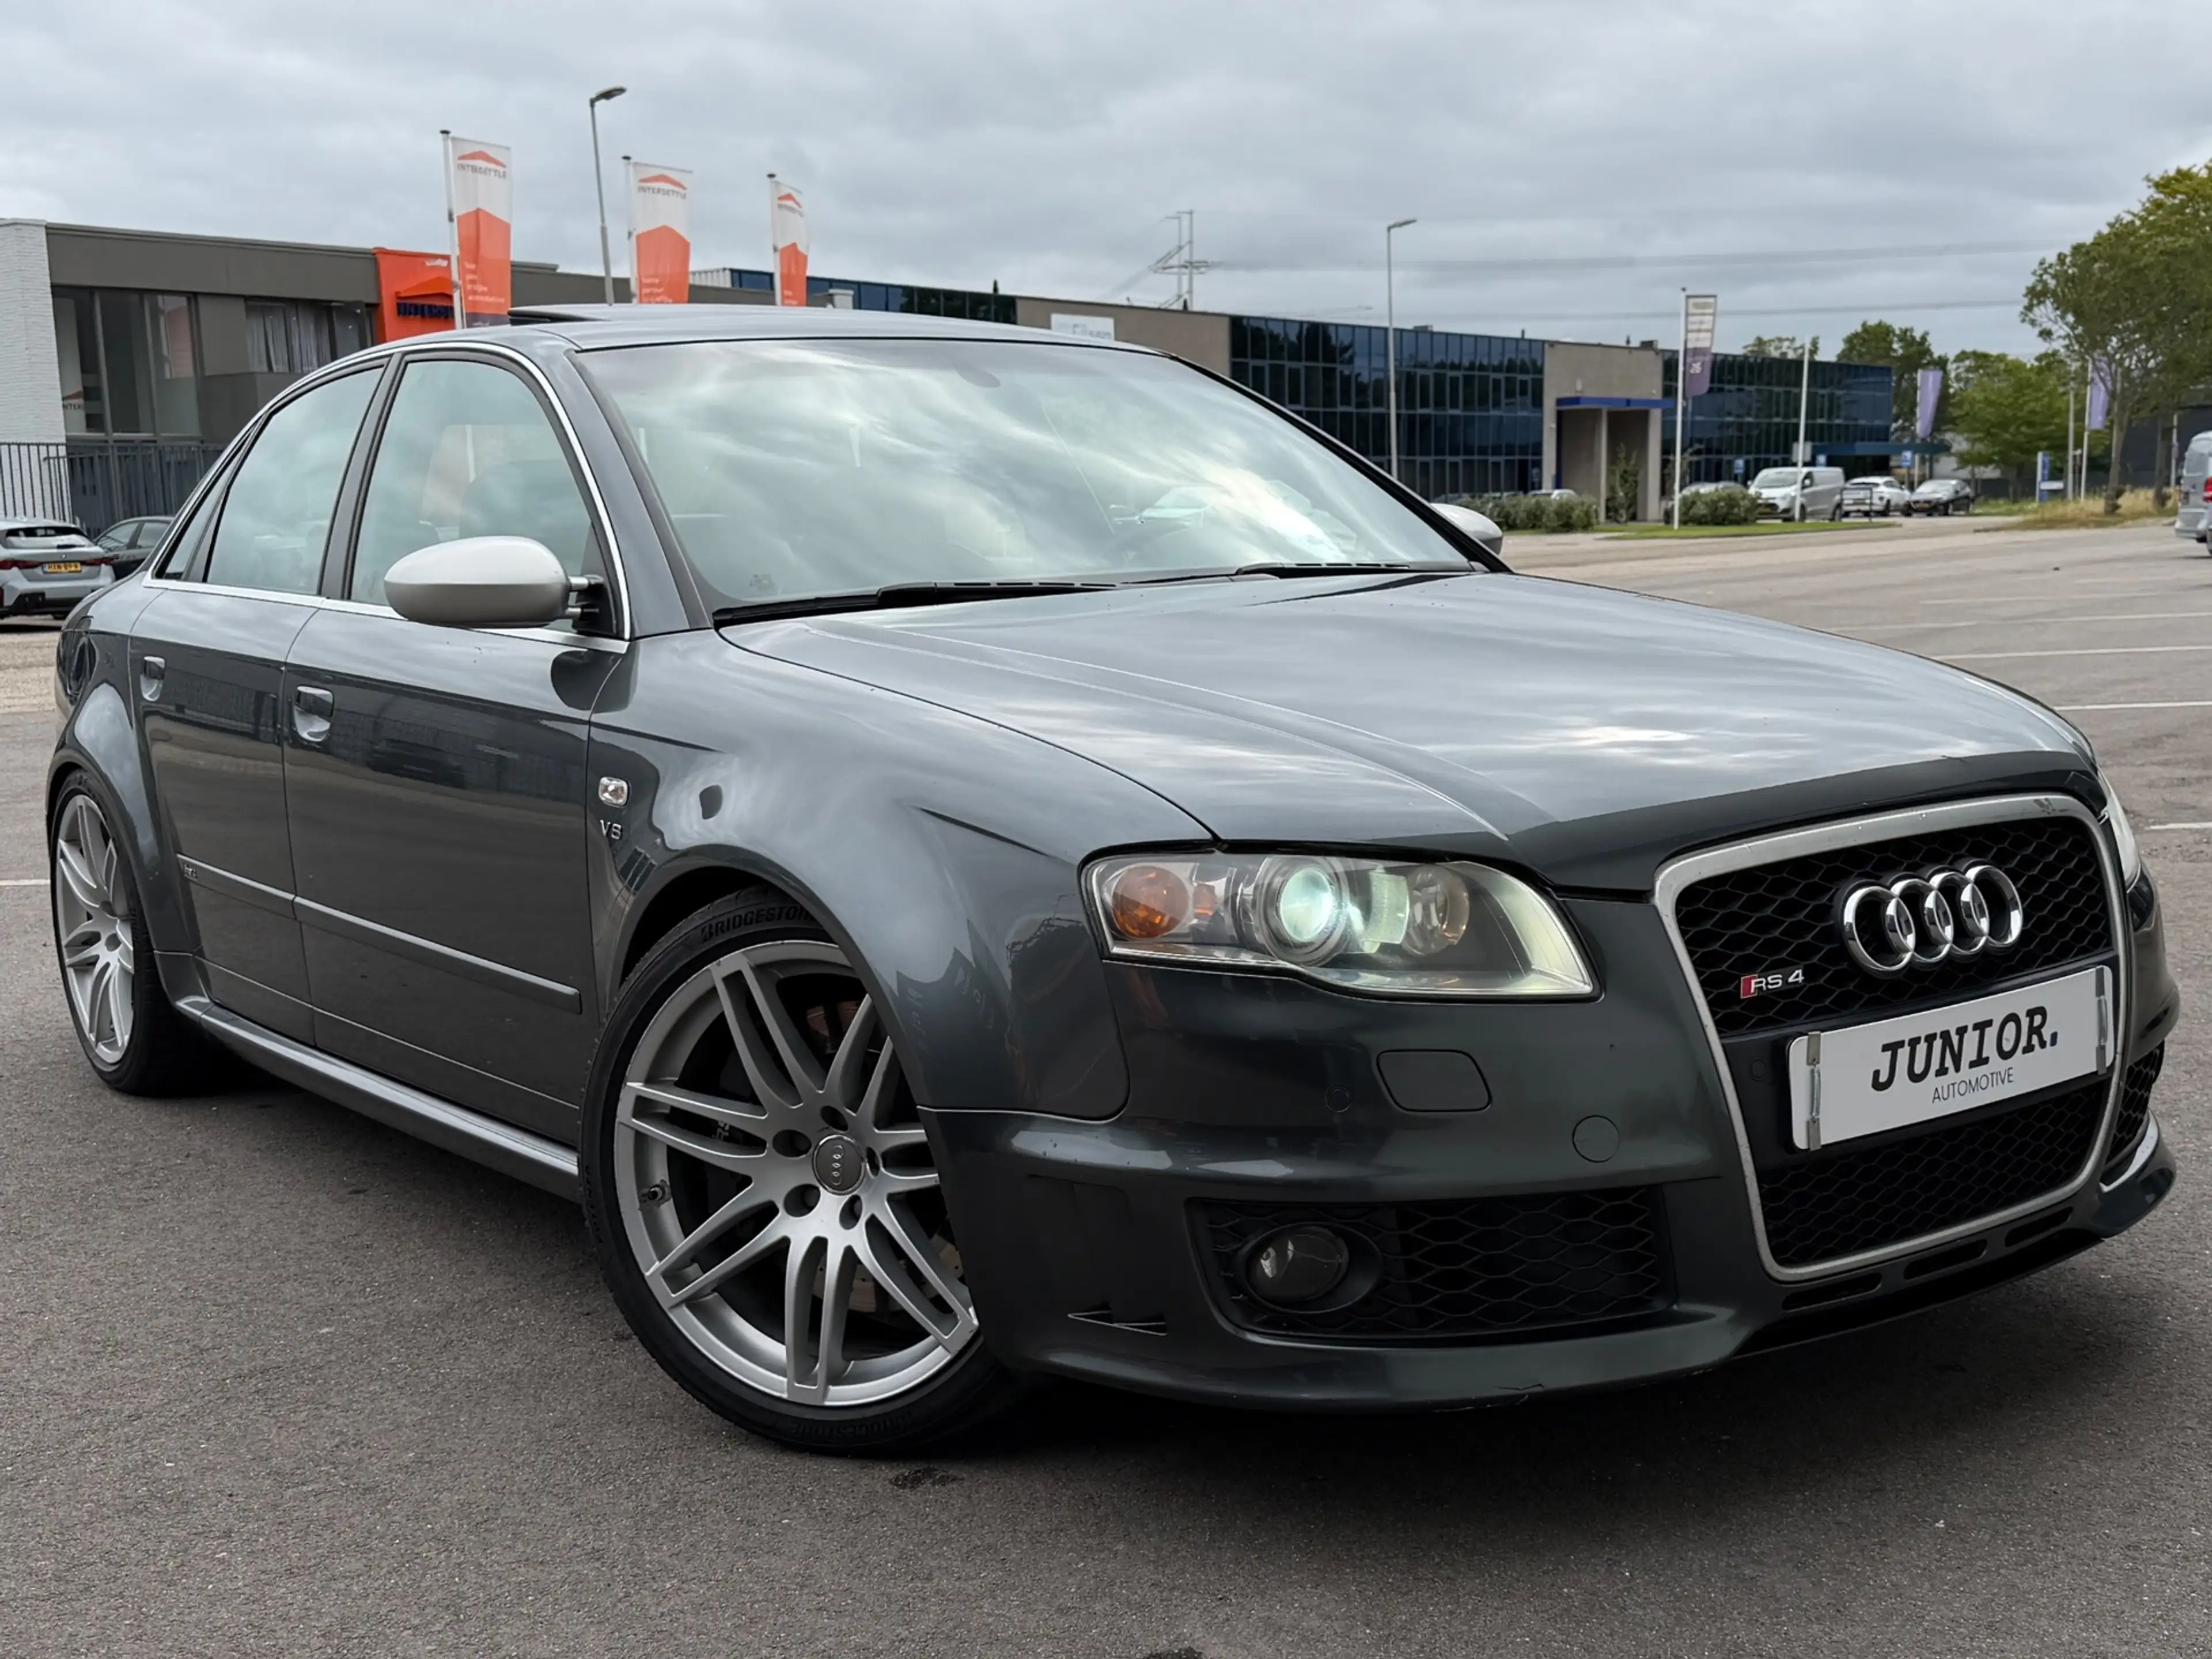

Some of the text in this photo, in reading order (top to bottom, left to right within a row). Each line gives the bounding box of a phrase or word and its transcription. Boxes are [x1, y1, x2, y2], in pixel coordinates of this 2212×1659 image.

[600, 819, 622, 840] V8
[700, 904, 815, 944] BRIDGESTON
[1871, 1006, 2058, 1092] JUNIOR.
[1931, 1067, 2014, 1104] AUTOMOTIVE
